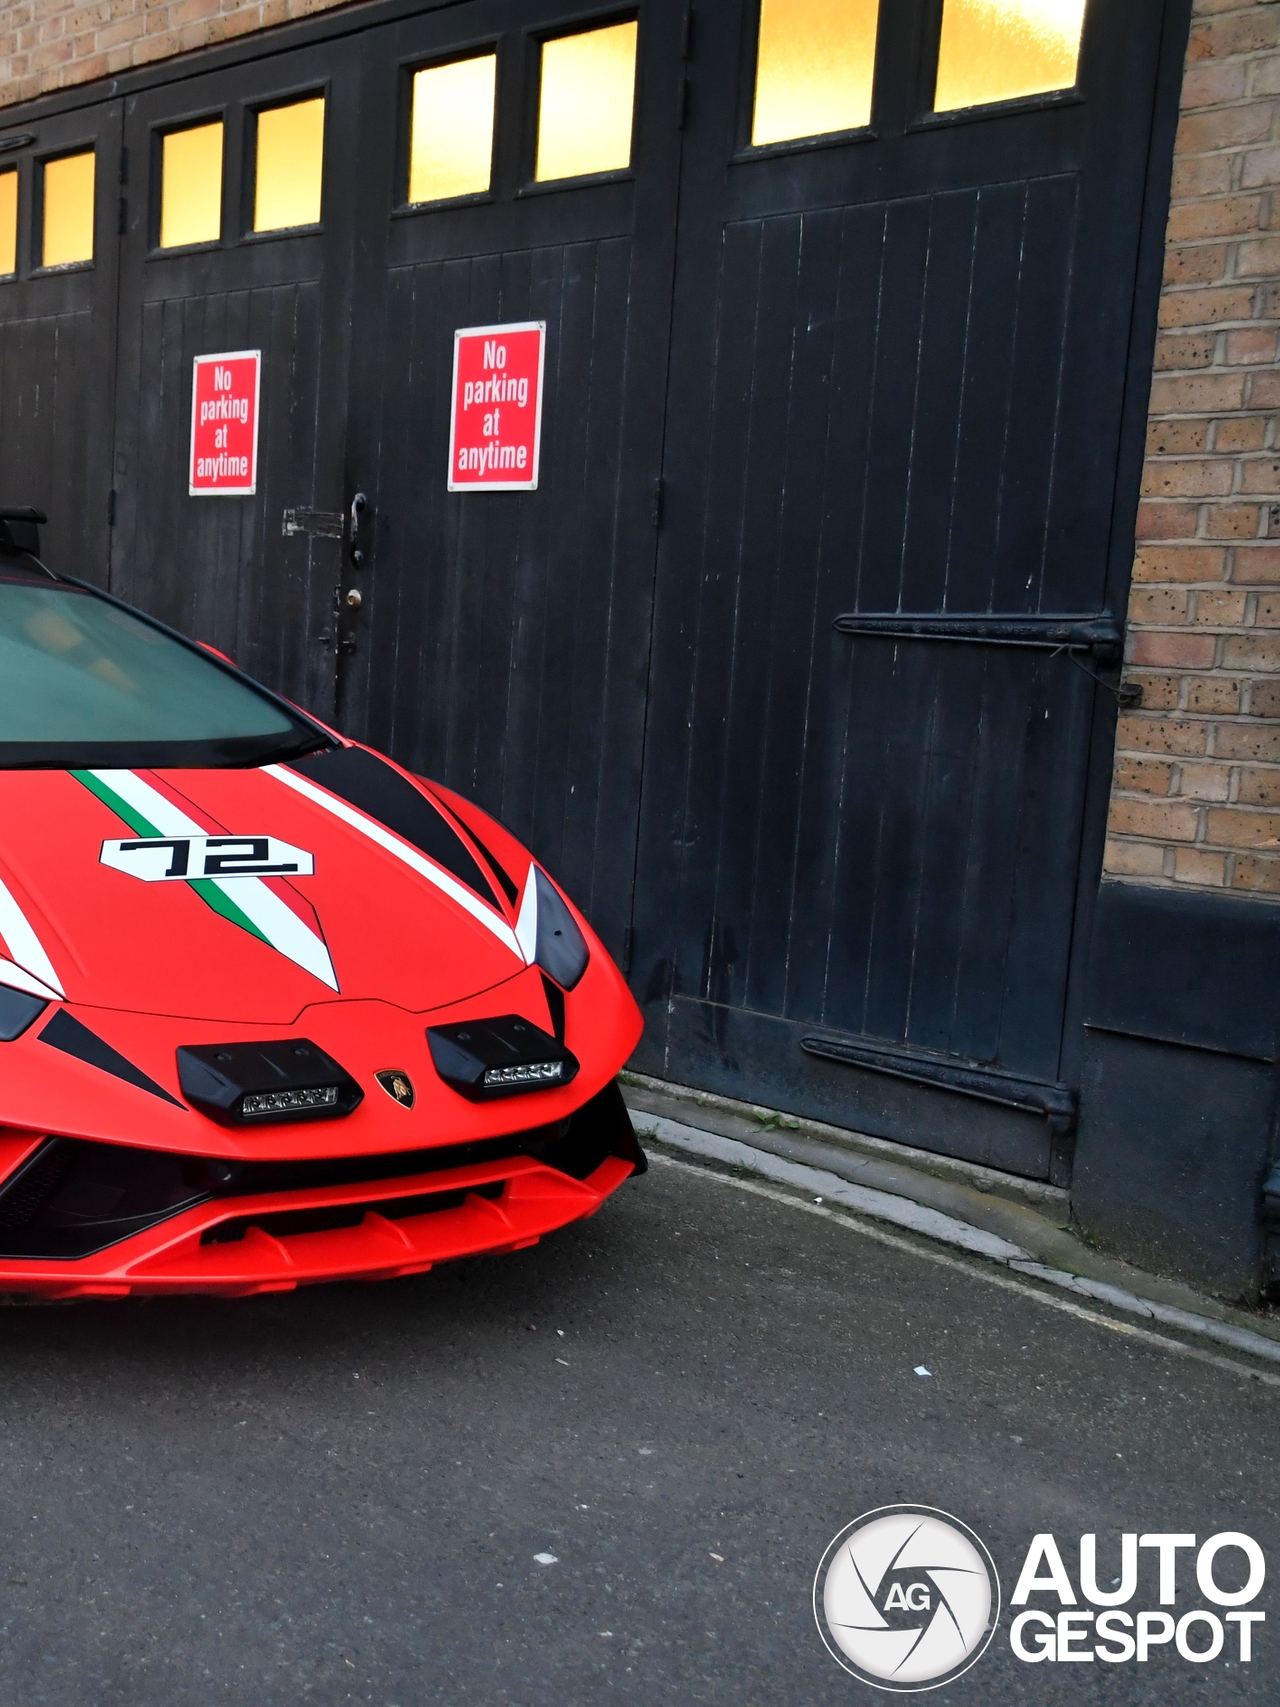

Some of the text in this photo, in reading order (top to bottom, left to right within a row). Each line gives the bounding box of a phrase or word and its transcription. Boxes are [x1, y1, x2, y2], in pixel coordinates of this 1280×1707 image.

[483, 340, 507, 369] No
[214, 366, 232, 391] No
[463, 373, 529, 411] parking
[200, 394, 249, 426] parking
[482, 408, 500, 436] at
[214, 424, 228, 448] at
[196, 452, 249, 482] anytime
[458, 440, 527, 476] anytime
[119, 838, 298, 877] 72
